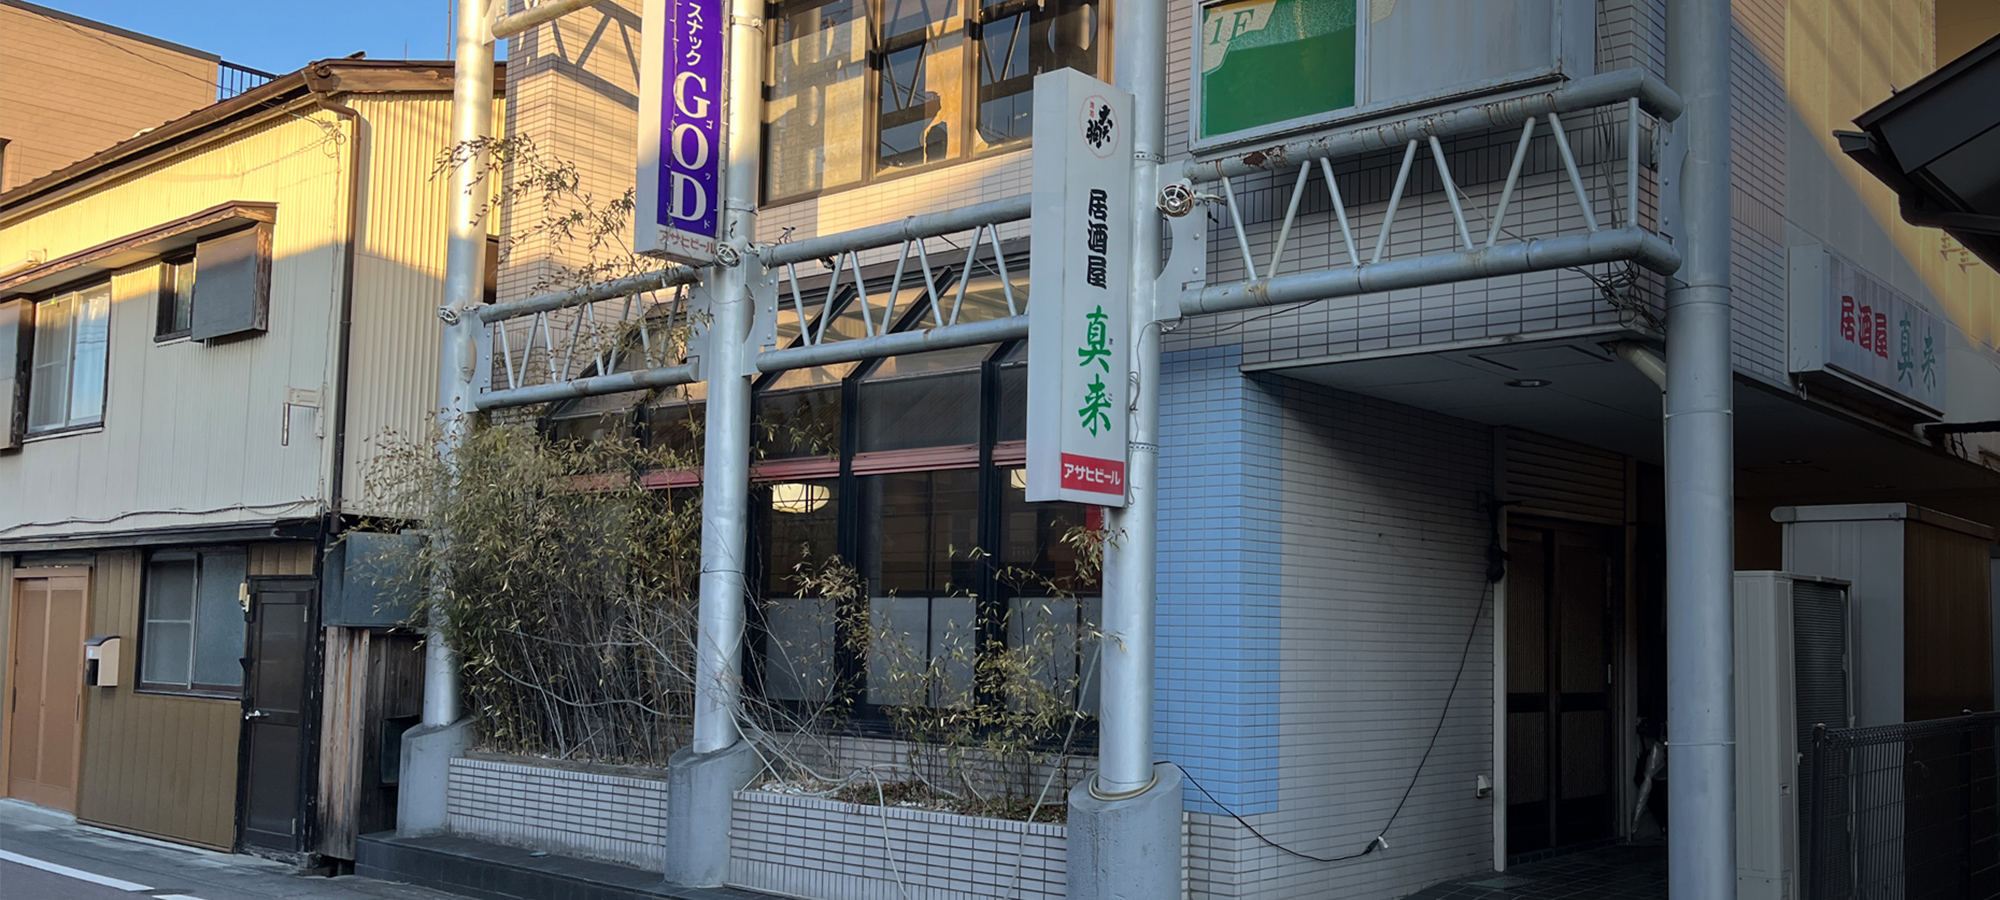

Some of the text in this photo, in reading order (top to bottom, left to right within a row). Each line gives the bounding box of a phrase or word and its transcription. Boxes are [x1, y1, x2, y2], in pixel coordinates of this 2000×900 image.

[686, 2, 703, 66] スナック
[1209, 8, 1255, 45] 1F
[671, 71, 711, 221] GOD
[659, 229, 715, 253] アサヒビール
[1078, 188, 1113, 438] 居酒屋 真来
[1840, 295, 1936, 393] 居酒屋 真来
[1064, 463, 1121, 486] アサヒビール
